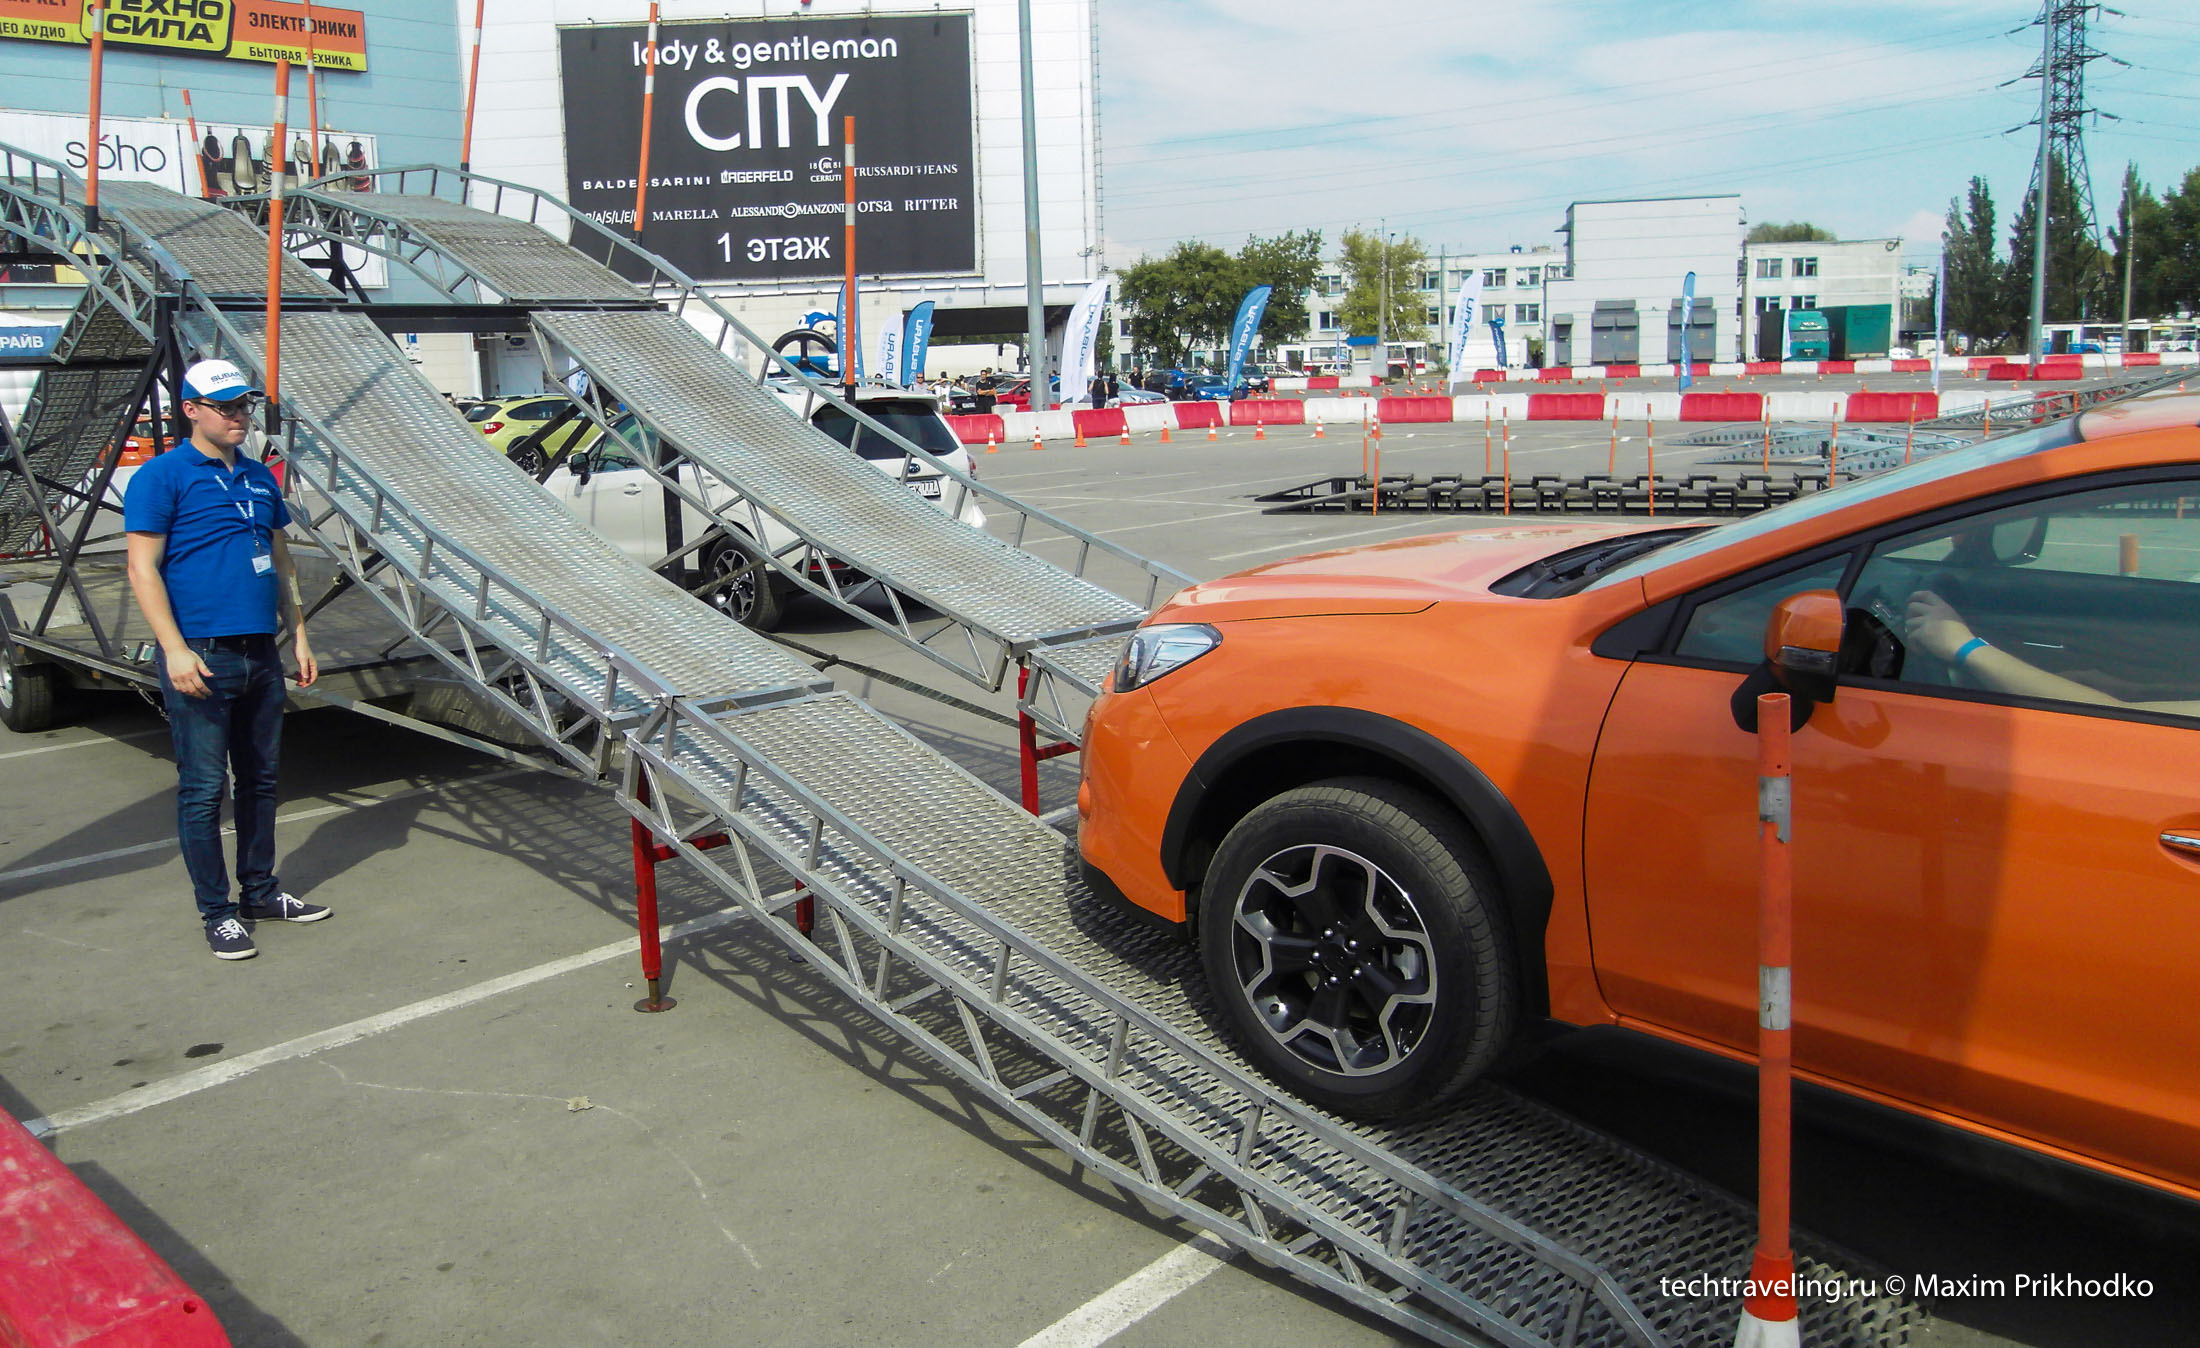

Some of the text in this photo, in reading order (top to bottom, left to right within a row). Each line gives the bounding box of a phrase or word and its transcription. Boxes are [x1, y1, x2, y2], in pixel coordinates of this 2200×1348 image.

[23, 24, 66, 39] АУДИО
[106, 13, 214, 44] СИЛА
[249, 46, 353, 67] БЫТОВАЯ ЕХНИКА
[633, 35, 898, 71] lady & gentleman
[684, 73, 850, 151] CITY
[65, 134, 167, 173] sóho
[853, 164, 958, 178] TRUSSARDI JEANS
[583, 176, 711, 190] BALDESARINI
[904, 198, 958, 212] RITTER
[652, 209, 719, 221] MARELLA
[717, 232, 831, 263] 1 этаж
[0, 333, 44, 351] РАЙВ
